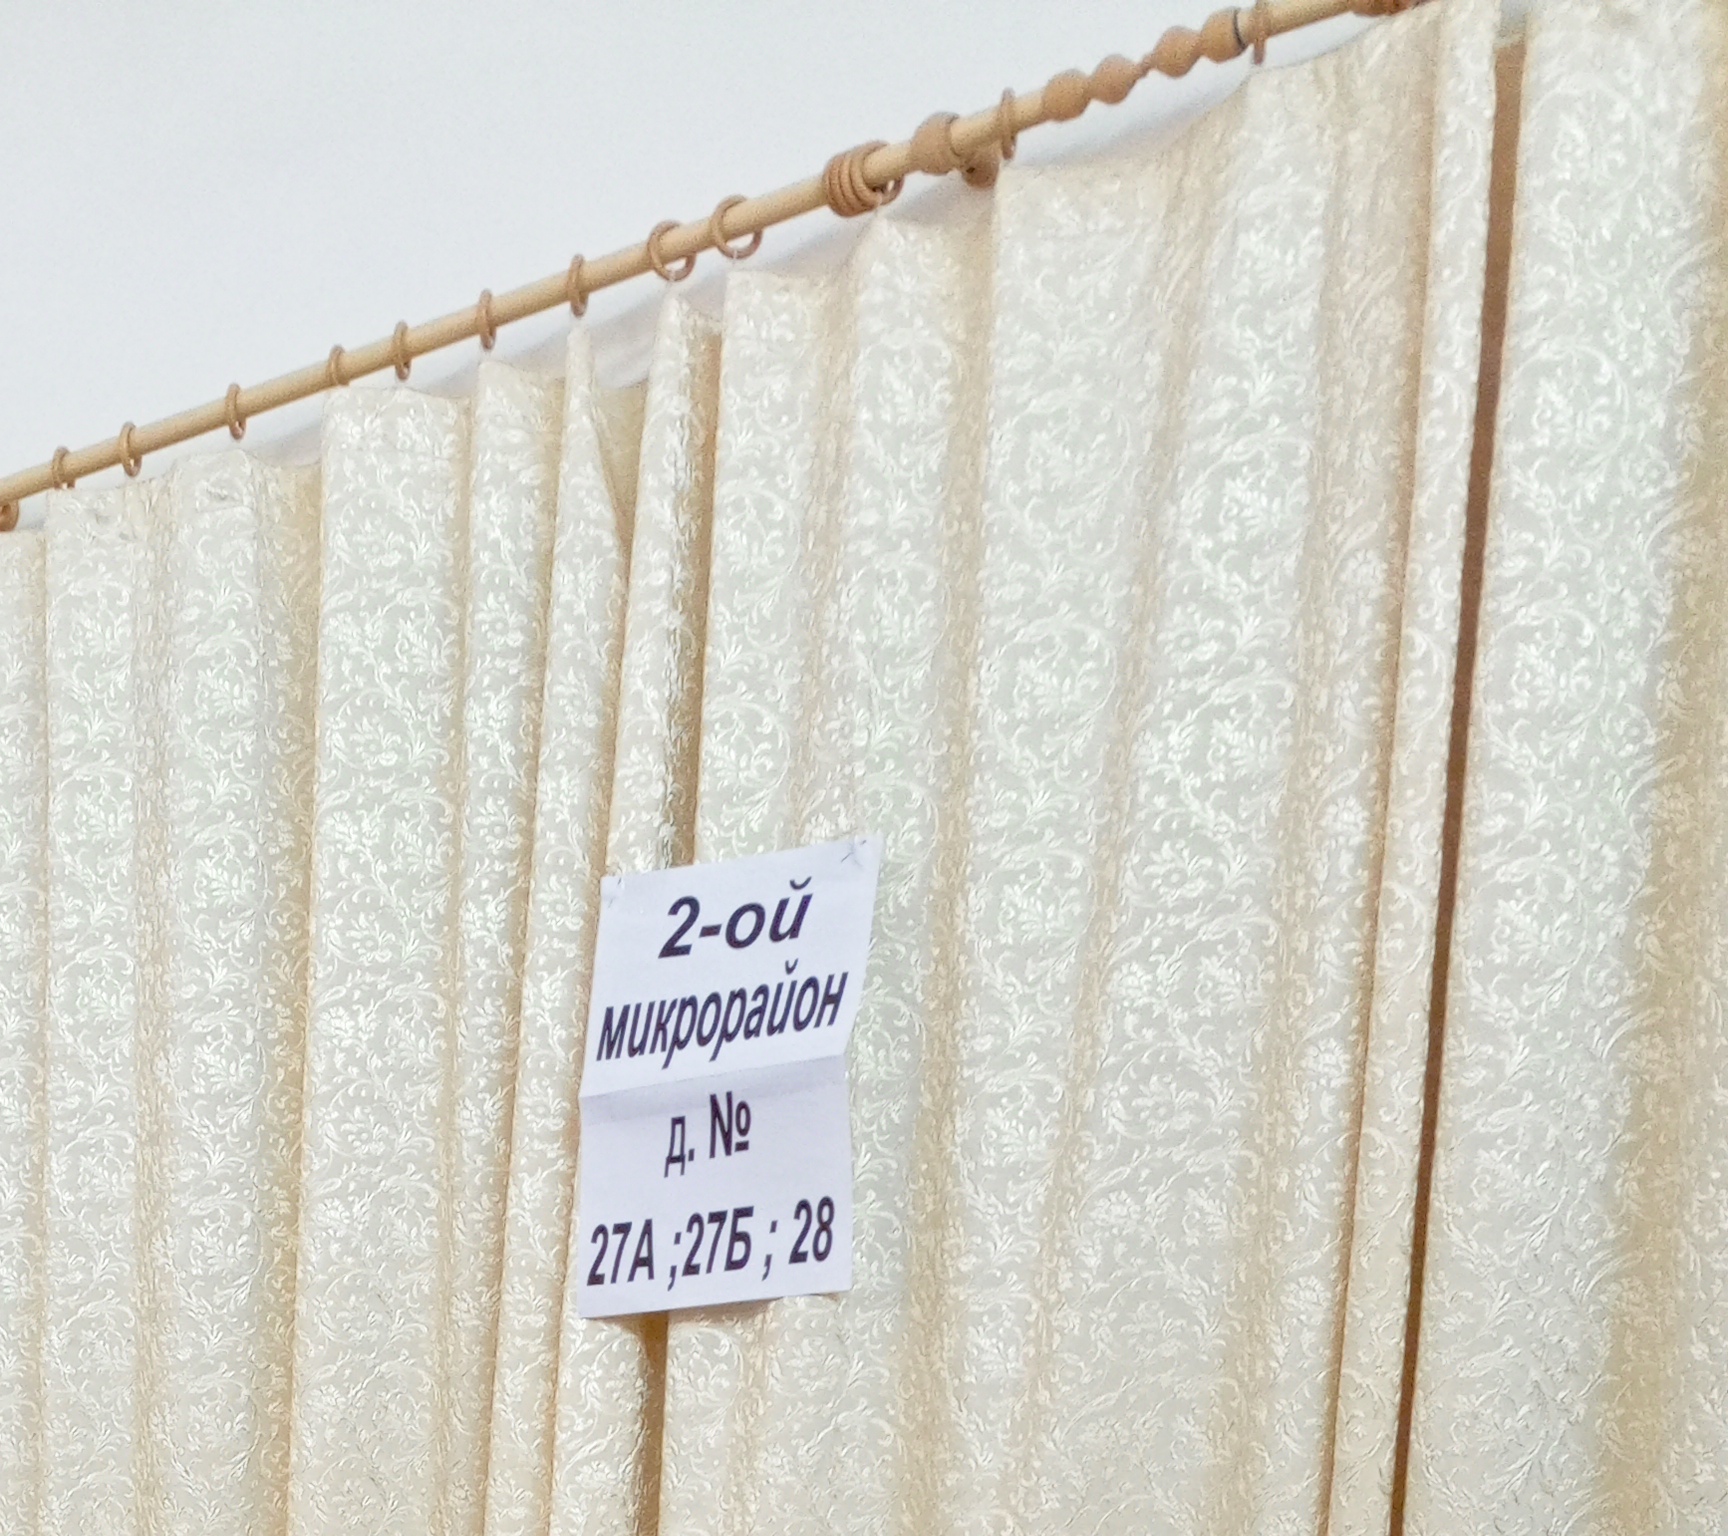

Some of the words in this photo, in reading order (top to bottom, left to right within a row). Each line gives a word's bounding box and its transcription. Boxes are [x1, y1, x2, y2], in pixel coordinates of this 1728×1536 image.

[657, 876, 813, 959] 2-ой
[595, 959, 849, 1070] микрорайон
[663, 1115, 695, 1179] д.
[708, 1090, 752, 1159] №
[788, 1196, 835, 1266] 28
